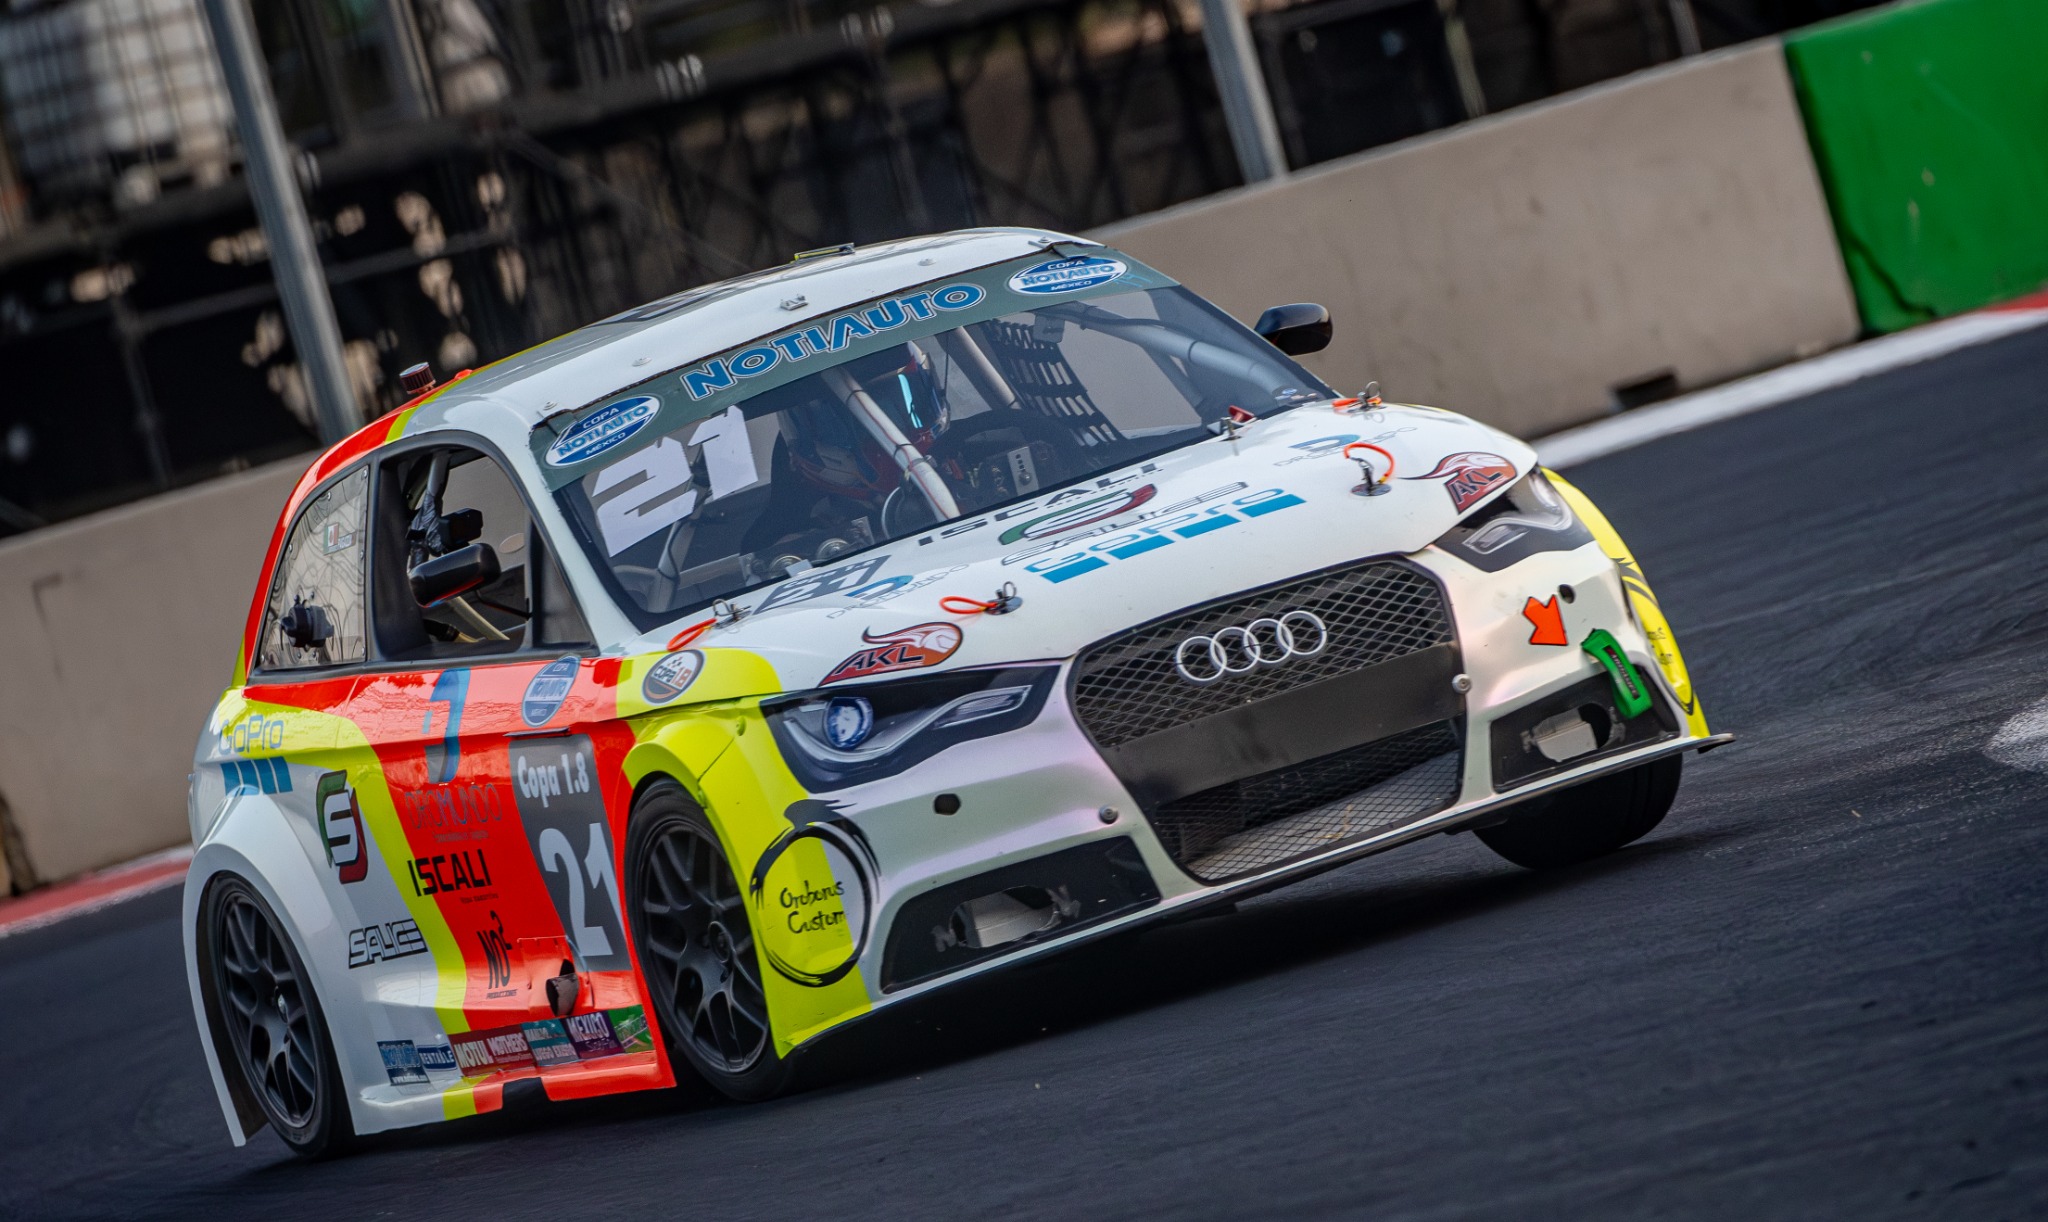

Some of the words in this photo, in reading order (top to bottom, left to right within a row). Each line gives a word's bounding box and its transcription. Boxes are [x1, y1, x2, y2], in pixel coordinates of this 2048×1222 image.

[1020, 264, 1115, 286] NOTIAUTO
[1047, 259, 1085, 270] COPA
[680, 283, 986, 400] NOTIAUTO
[557, 405, 650, 457] NOTIAUTO
[583, 407, 619, 429] COPA
[592, 404, 759, 558] 21
[1448, 470, 1504, 504] AKL
[919, 463, 1160, 546] ISCALI
[761, 567, 870, 611] 21
[832, 646, 924, 677] AKL
[218, 715, 284, 755] GoPro
[518, 755, 561, 808] Copa
[561, 752, 590, 794] 1.8
[407, 848, 492, 897] ISCALI
[539, 822, 627, 957] 21
[453, 1040, 495, 1069] MOTUL
[486, 1032, 529, 1057] MOTHERS
